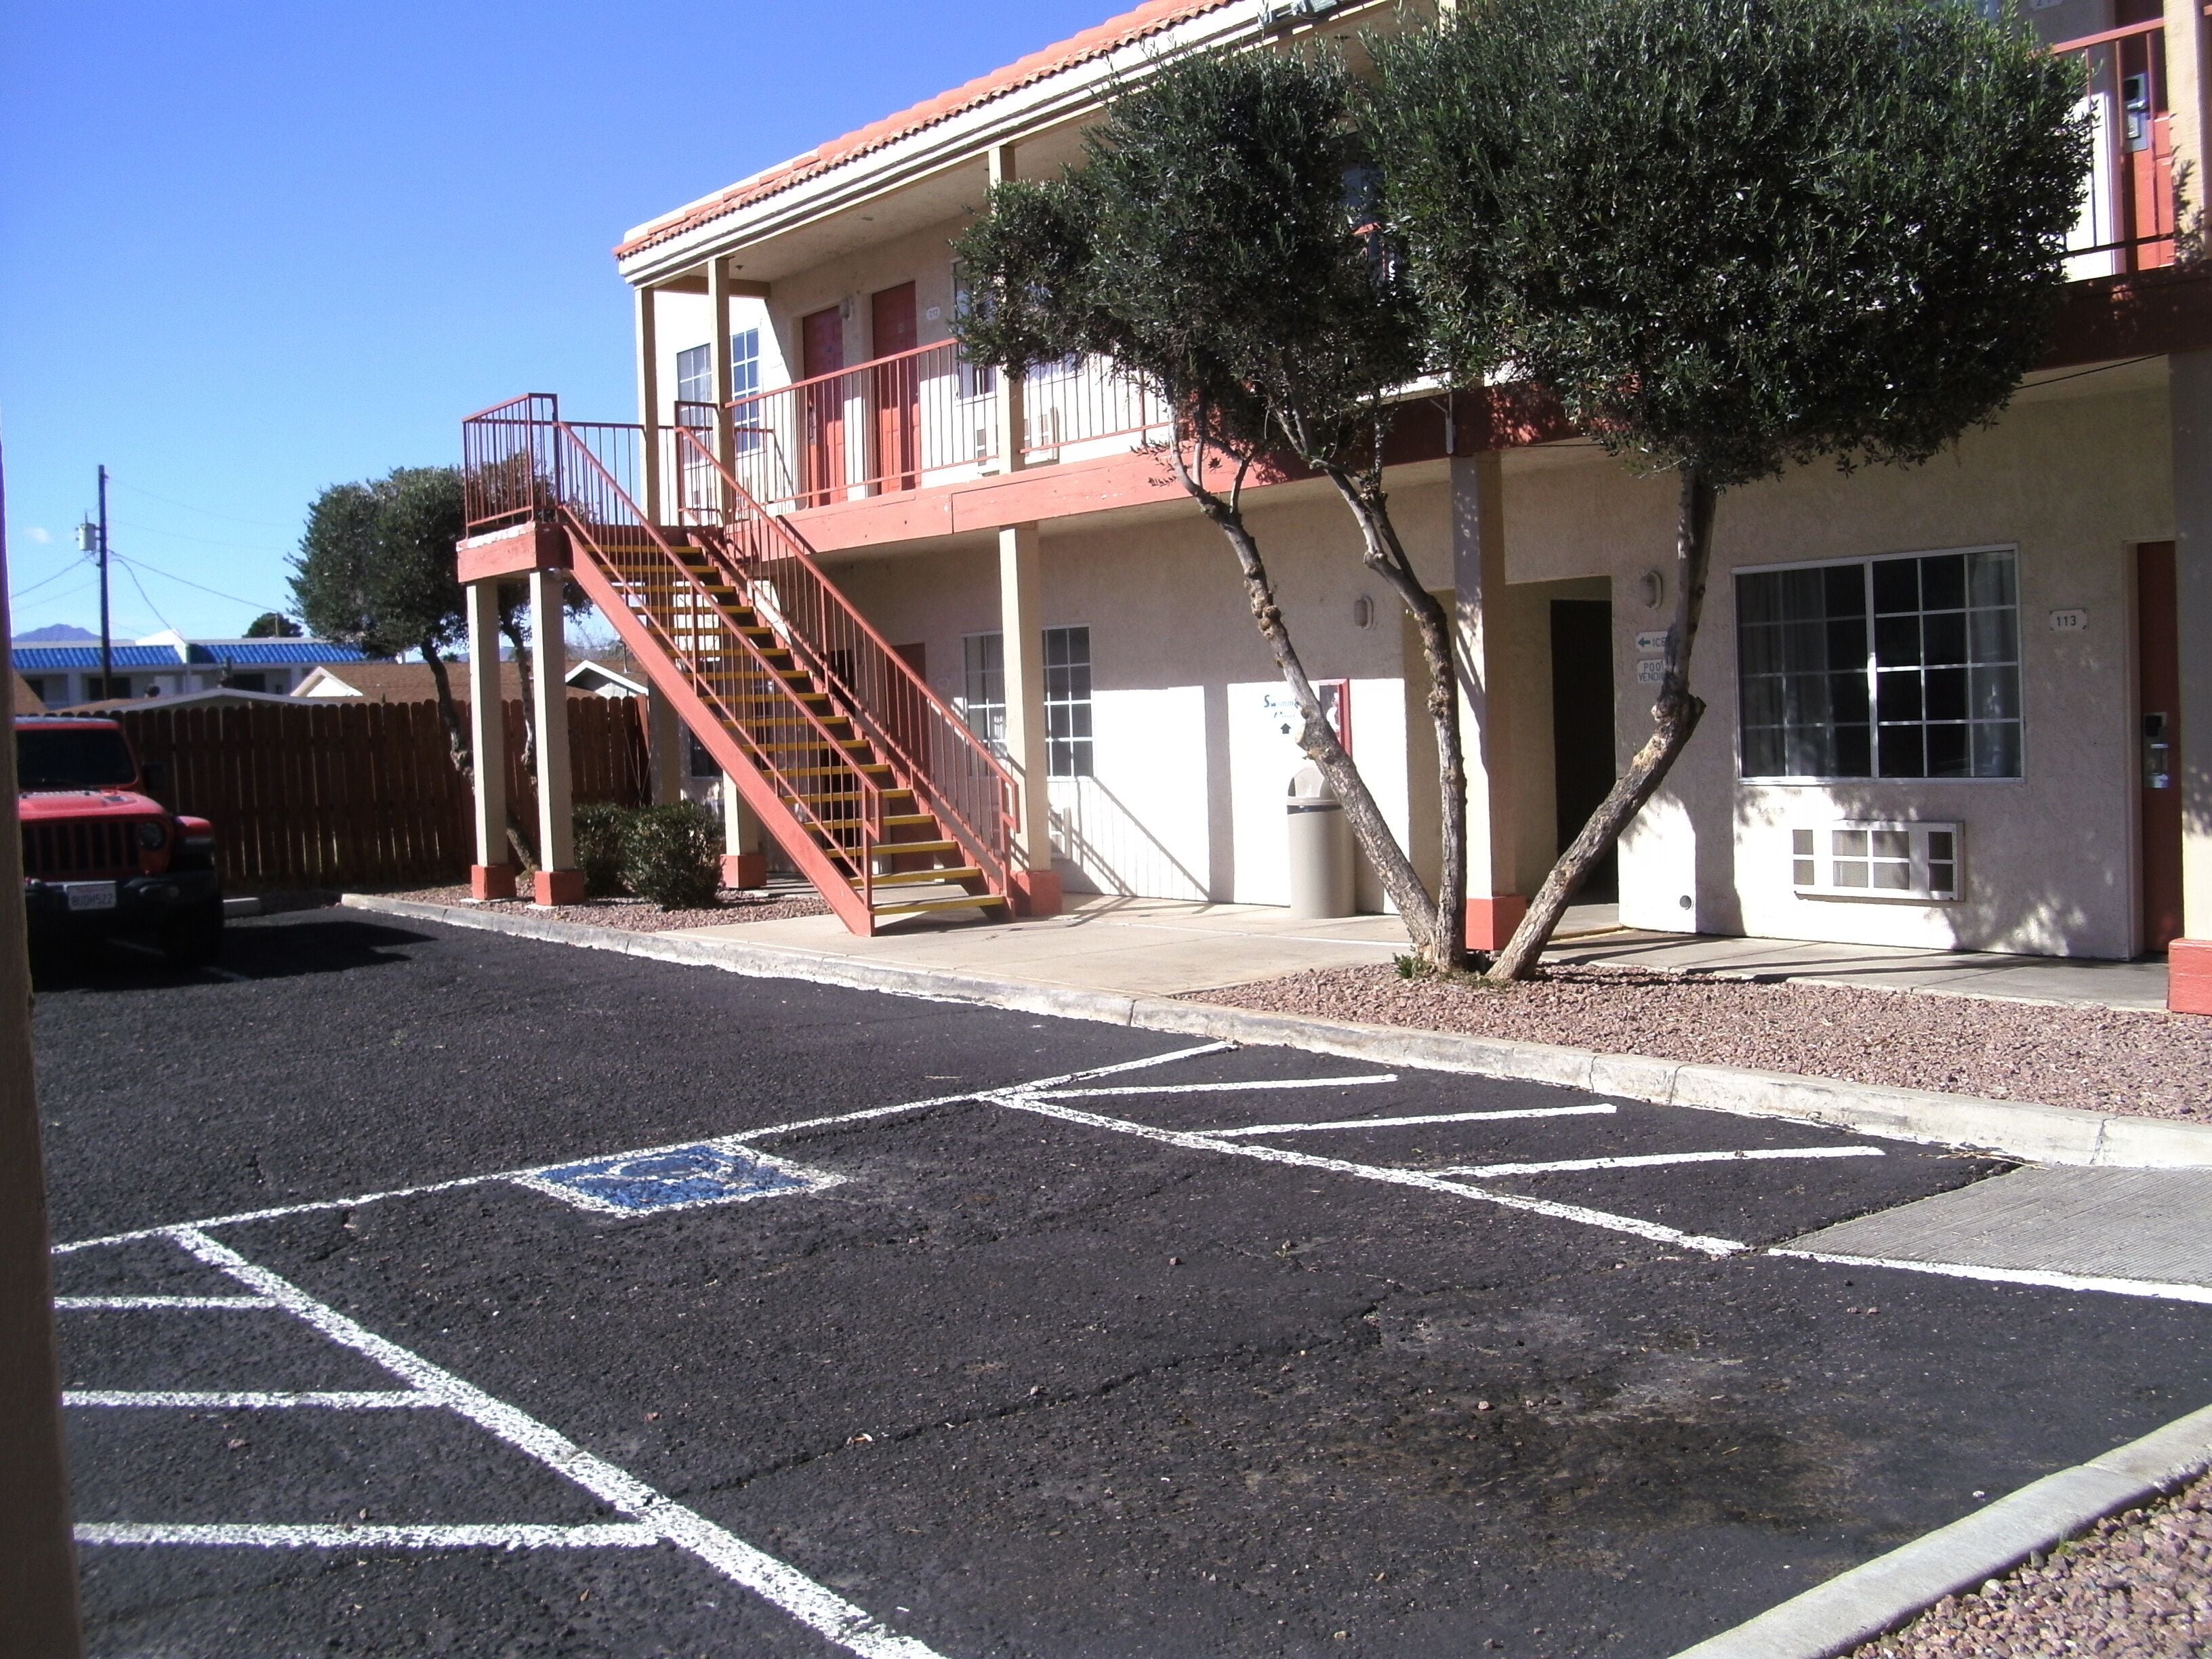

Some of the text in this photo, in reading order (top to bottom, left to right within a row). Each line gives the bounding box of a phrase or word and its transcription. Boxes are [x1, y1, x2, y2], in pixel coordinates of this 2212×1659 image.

[2057, 615, 2076, 626] 113
[1652, 637, 1666, 647] ICE
[1639, 672, 1664, 682] VENDI
